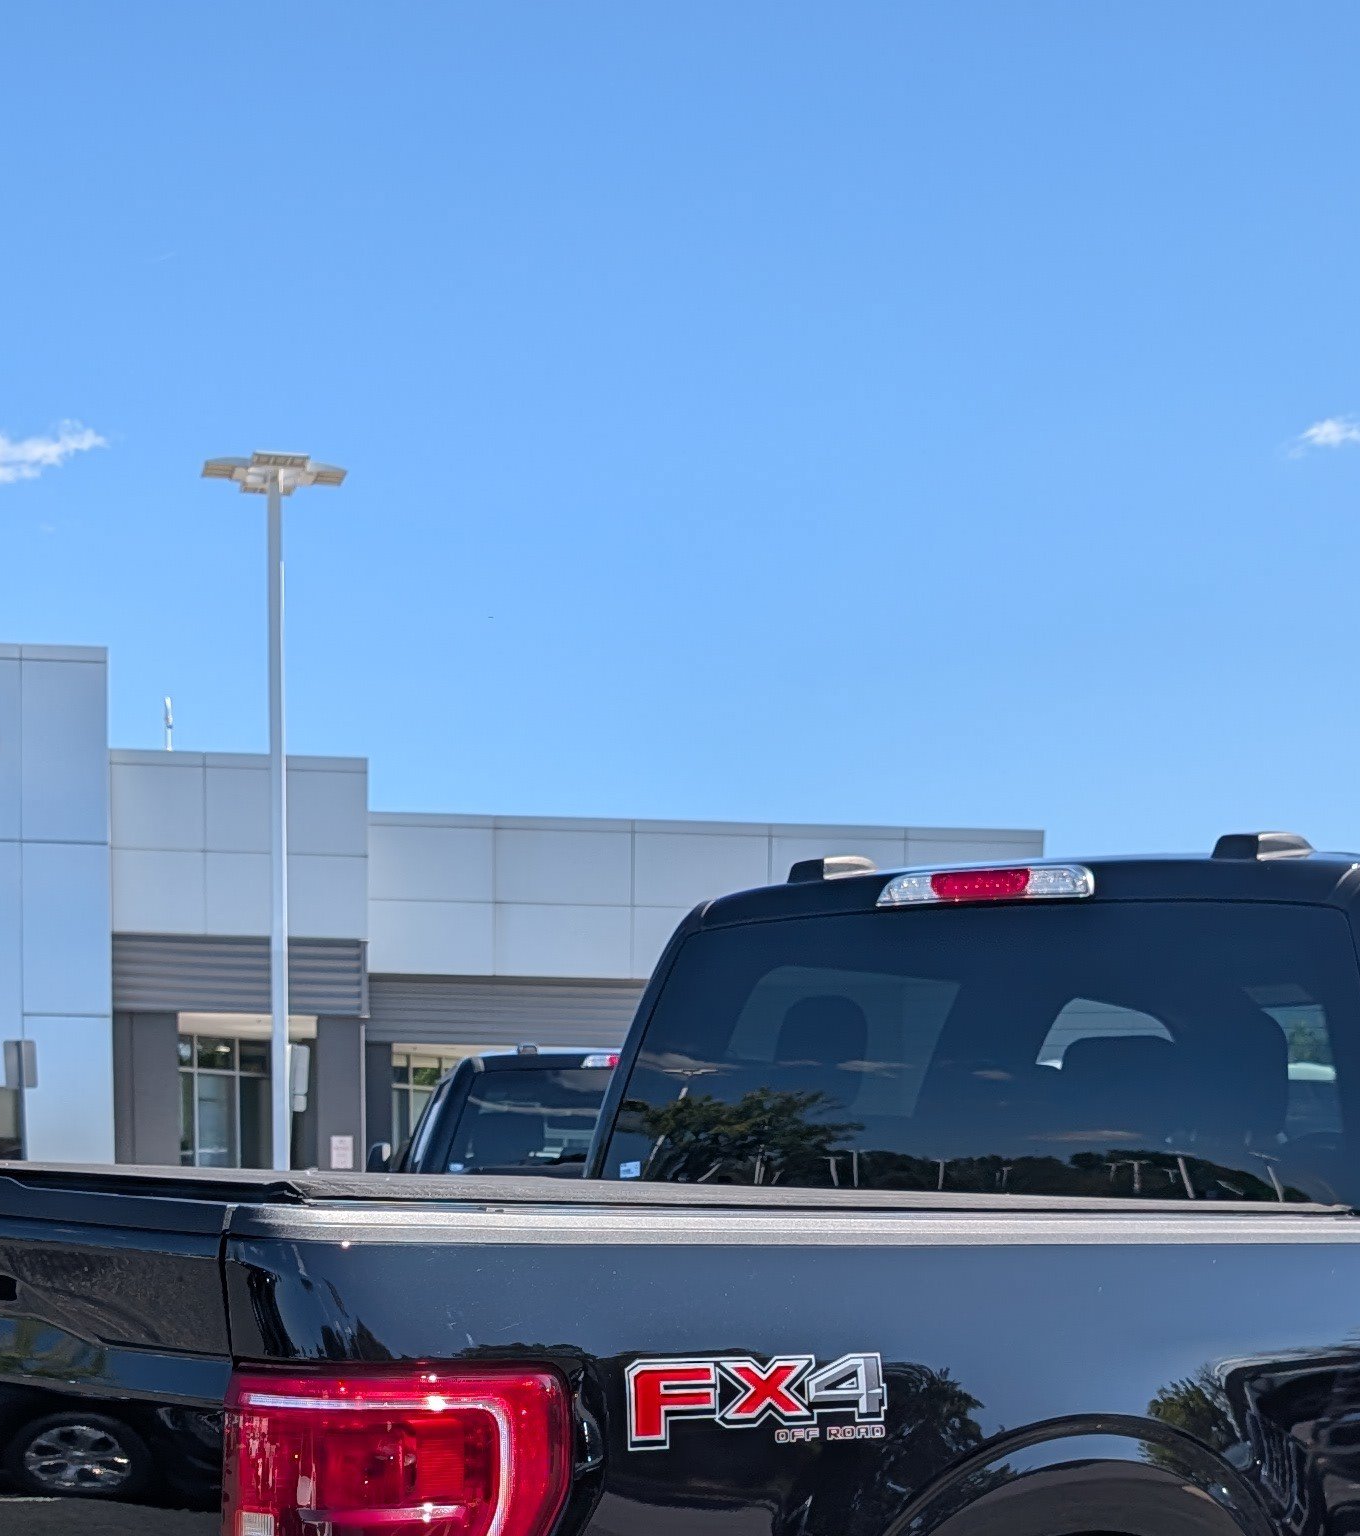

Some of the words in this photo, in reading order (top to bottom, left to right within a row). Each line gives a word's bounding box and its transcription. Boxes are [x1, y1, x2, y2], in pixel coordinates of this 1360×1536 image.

[625, 1352, 888, 1452] FX4
[775, 1427, 820, 1444] OFF
[826, 1424, 886, 1441] ROAD
